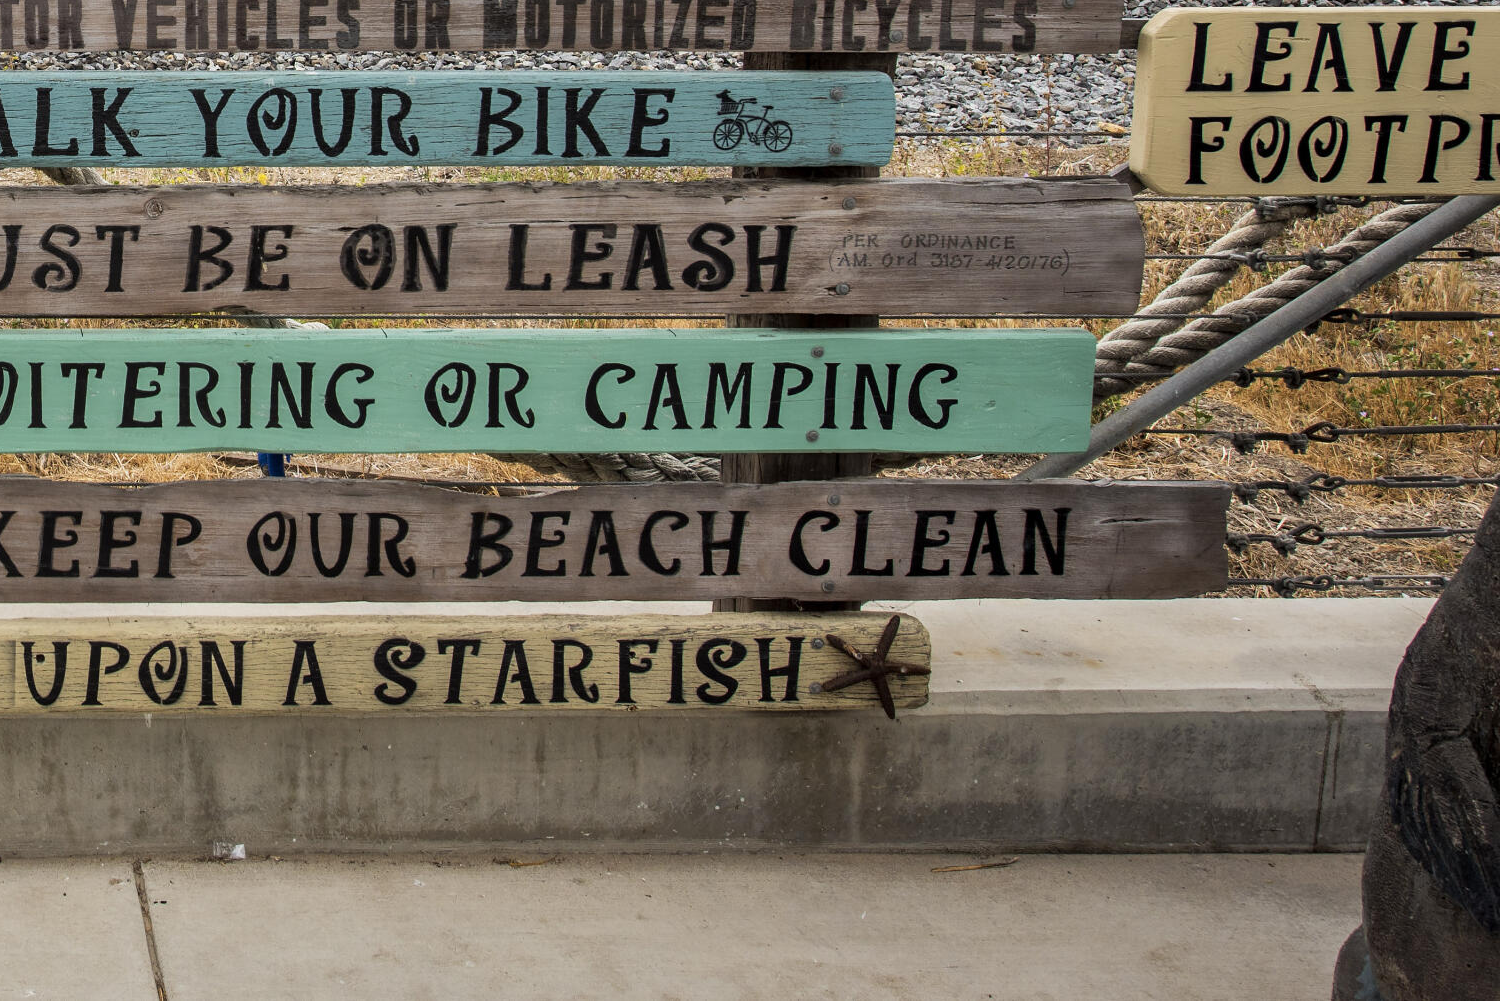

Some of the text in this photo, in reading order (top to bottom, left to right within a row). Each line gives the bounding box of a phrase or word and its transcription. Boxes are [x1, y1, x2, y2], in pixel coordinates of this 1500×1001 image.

[1186, 21, 1475, 92] LEAVE
[189, 87, 419, 157] YOUR
[471, 87, 675, 158] BIKE
[182, 225, 294, 292] BE
[339, 223, 457, 292] ON
[506, 223, 798, 292] LEASH
[842, 233, 1016, 249] PER ORDINANCE
[882, 252, 917, 267] Ord
[425, 363, 535, 428] OR
[585, 363, 959, 430] CAMPING
[247, 512, 416, 578] OUR
[461, 510, 749, 579] BEACH
[789, 507, 1072, 576] CLEAN
[21, 641, 246, 706] UPON
[282, 641, 332, 705] A
[374, 636, 805, 705] STARFISH
